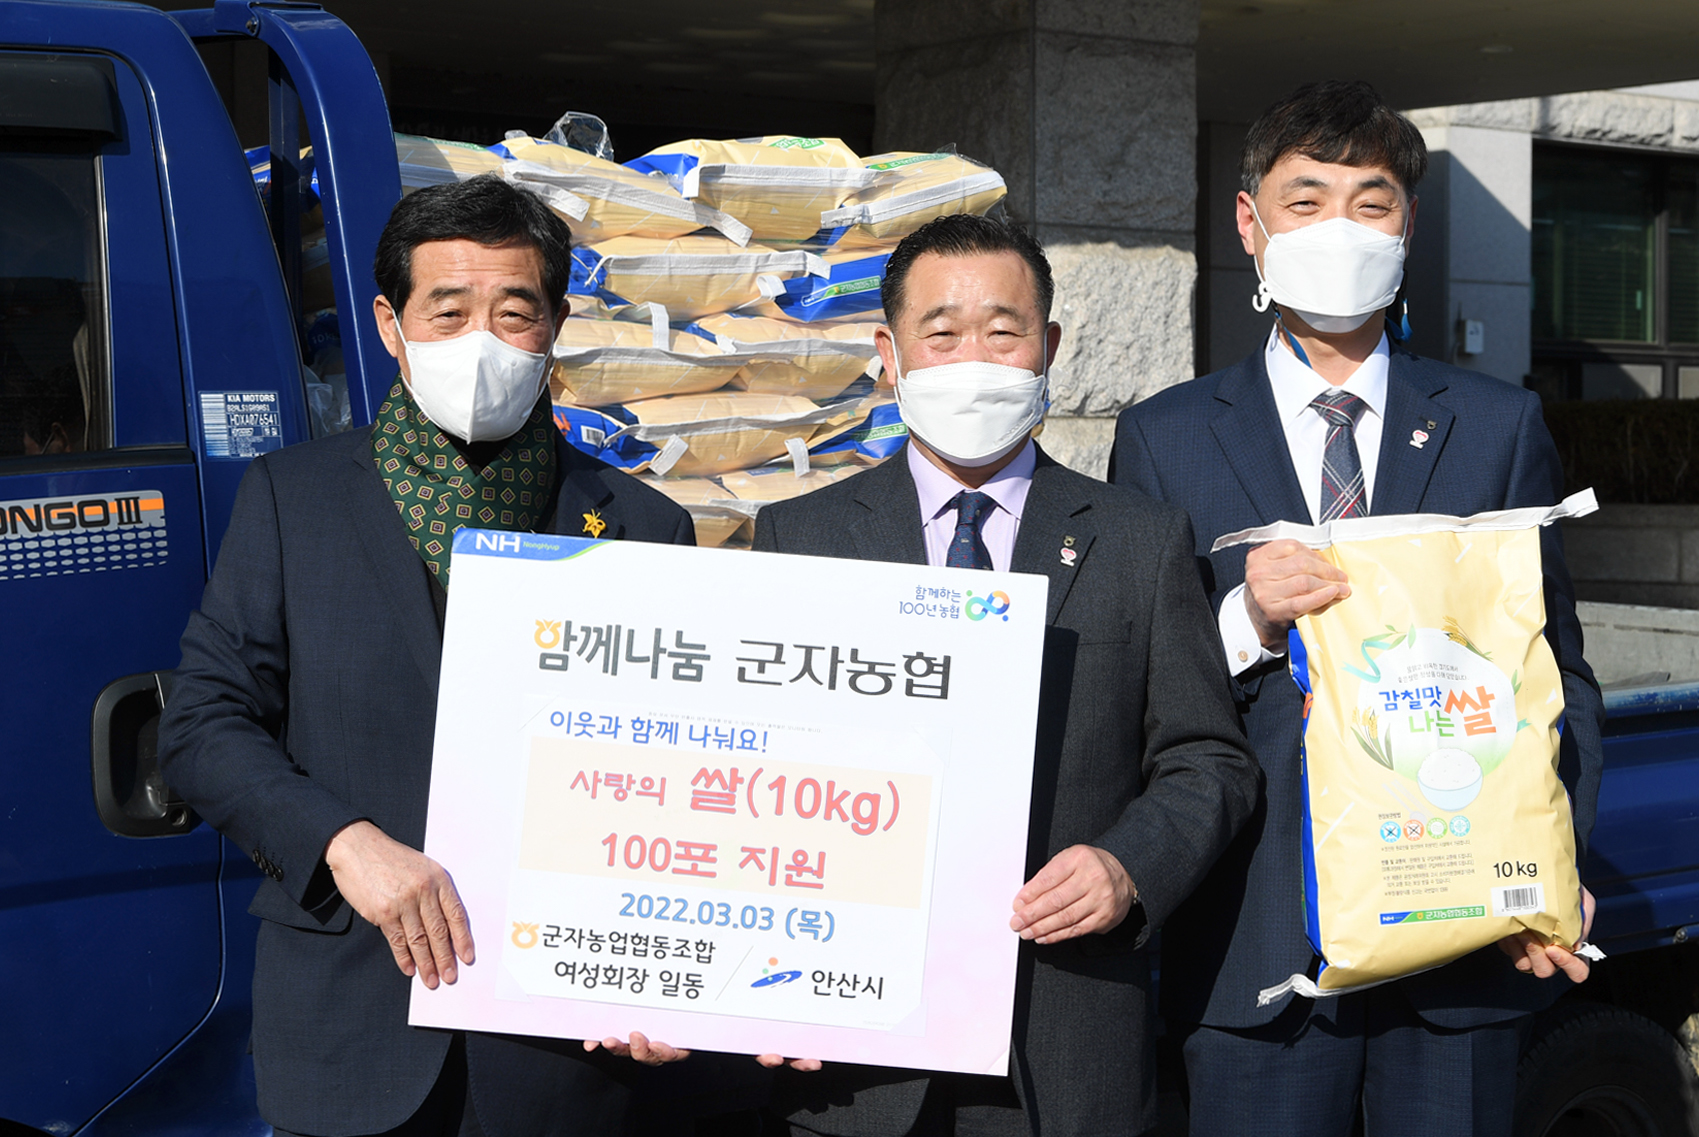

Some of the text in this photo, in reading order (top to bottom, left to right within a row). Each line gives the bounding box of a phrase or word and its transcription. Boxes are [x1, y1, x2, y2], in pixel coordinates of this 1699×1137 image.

[227, 394, 275, 402] KIA MOTORS
[0, 499, 110, 535] NGO
[475, 532, 521, 553] NH
[899, 601, 960, 619] 100년 농협
[915, 585, 961, 603] 함께하는
[735, 639, 952, 701] 군자농협
[1379, 685, 1442, 711] 감칠맛
[1408, 685, 1497, 737] 나는 쌀
[550, 709, 623, 740] 이웃과
[630, 717, 680, 746] 함께
[688, 724, 769, 754] 나눠요!
[570, 767, 900, 836] 사랑의 쌀(10kg)
[600, 832, 827, 890] 100포 지원
[618, 892, 836, 943] 2022.03.03 (목)
[542, 924, 717, 964] 군자농업협동조합
[554, 961, 705, 1000] 여성회장 일동
[811, 969, 884, 1001] 안산시
